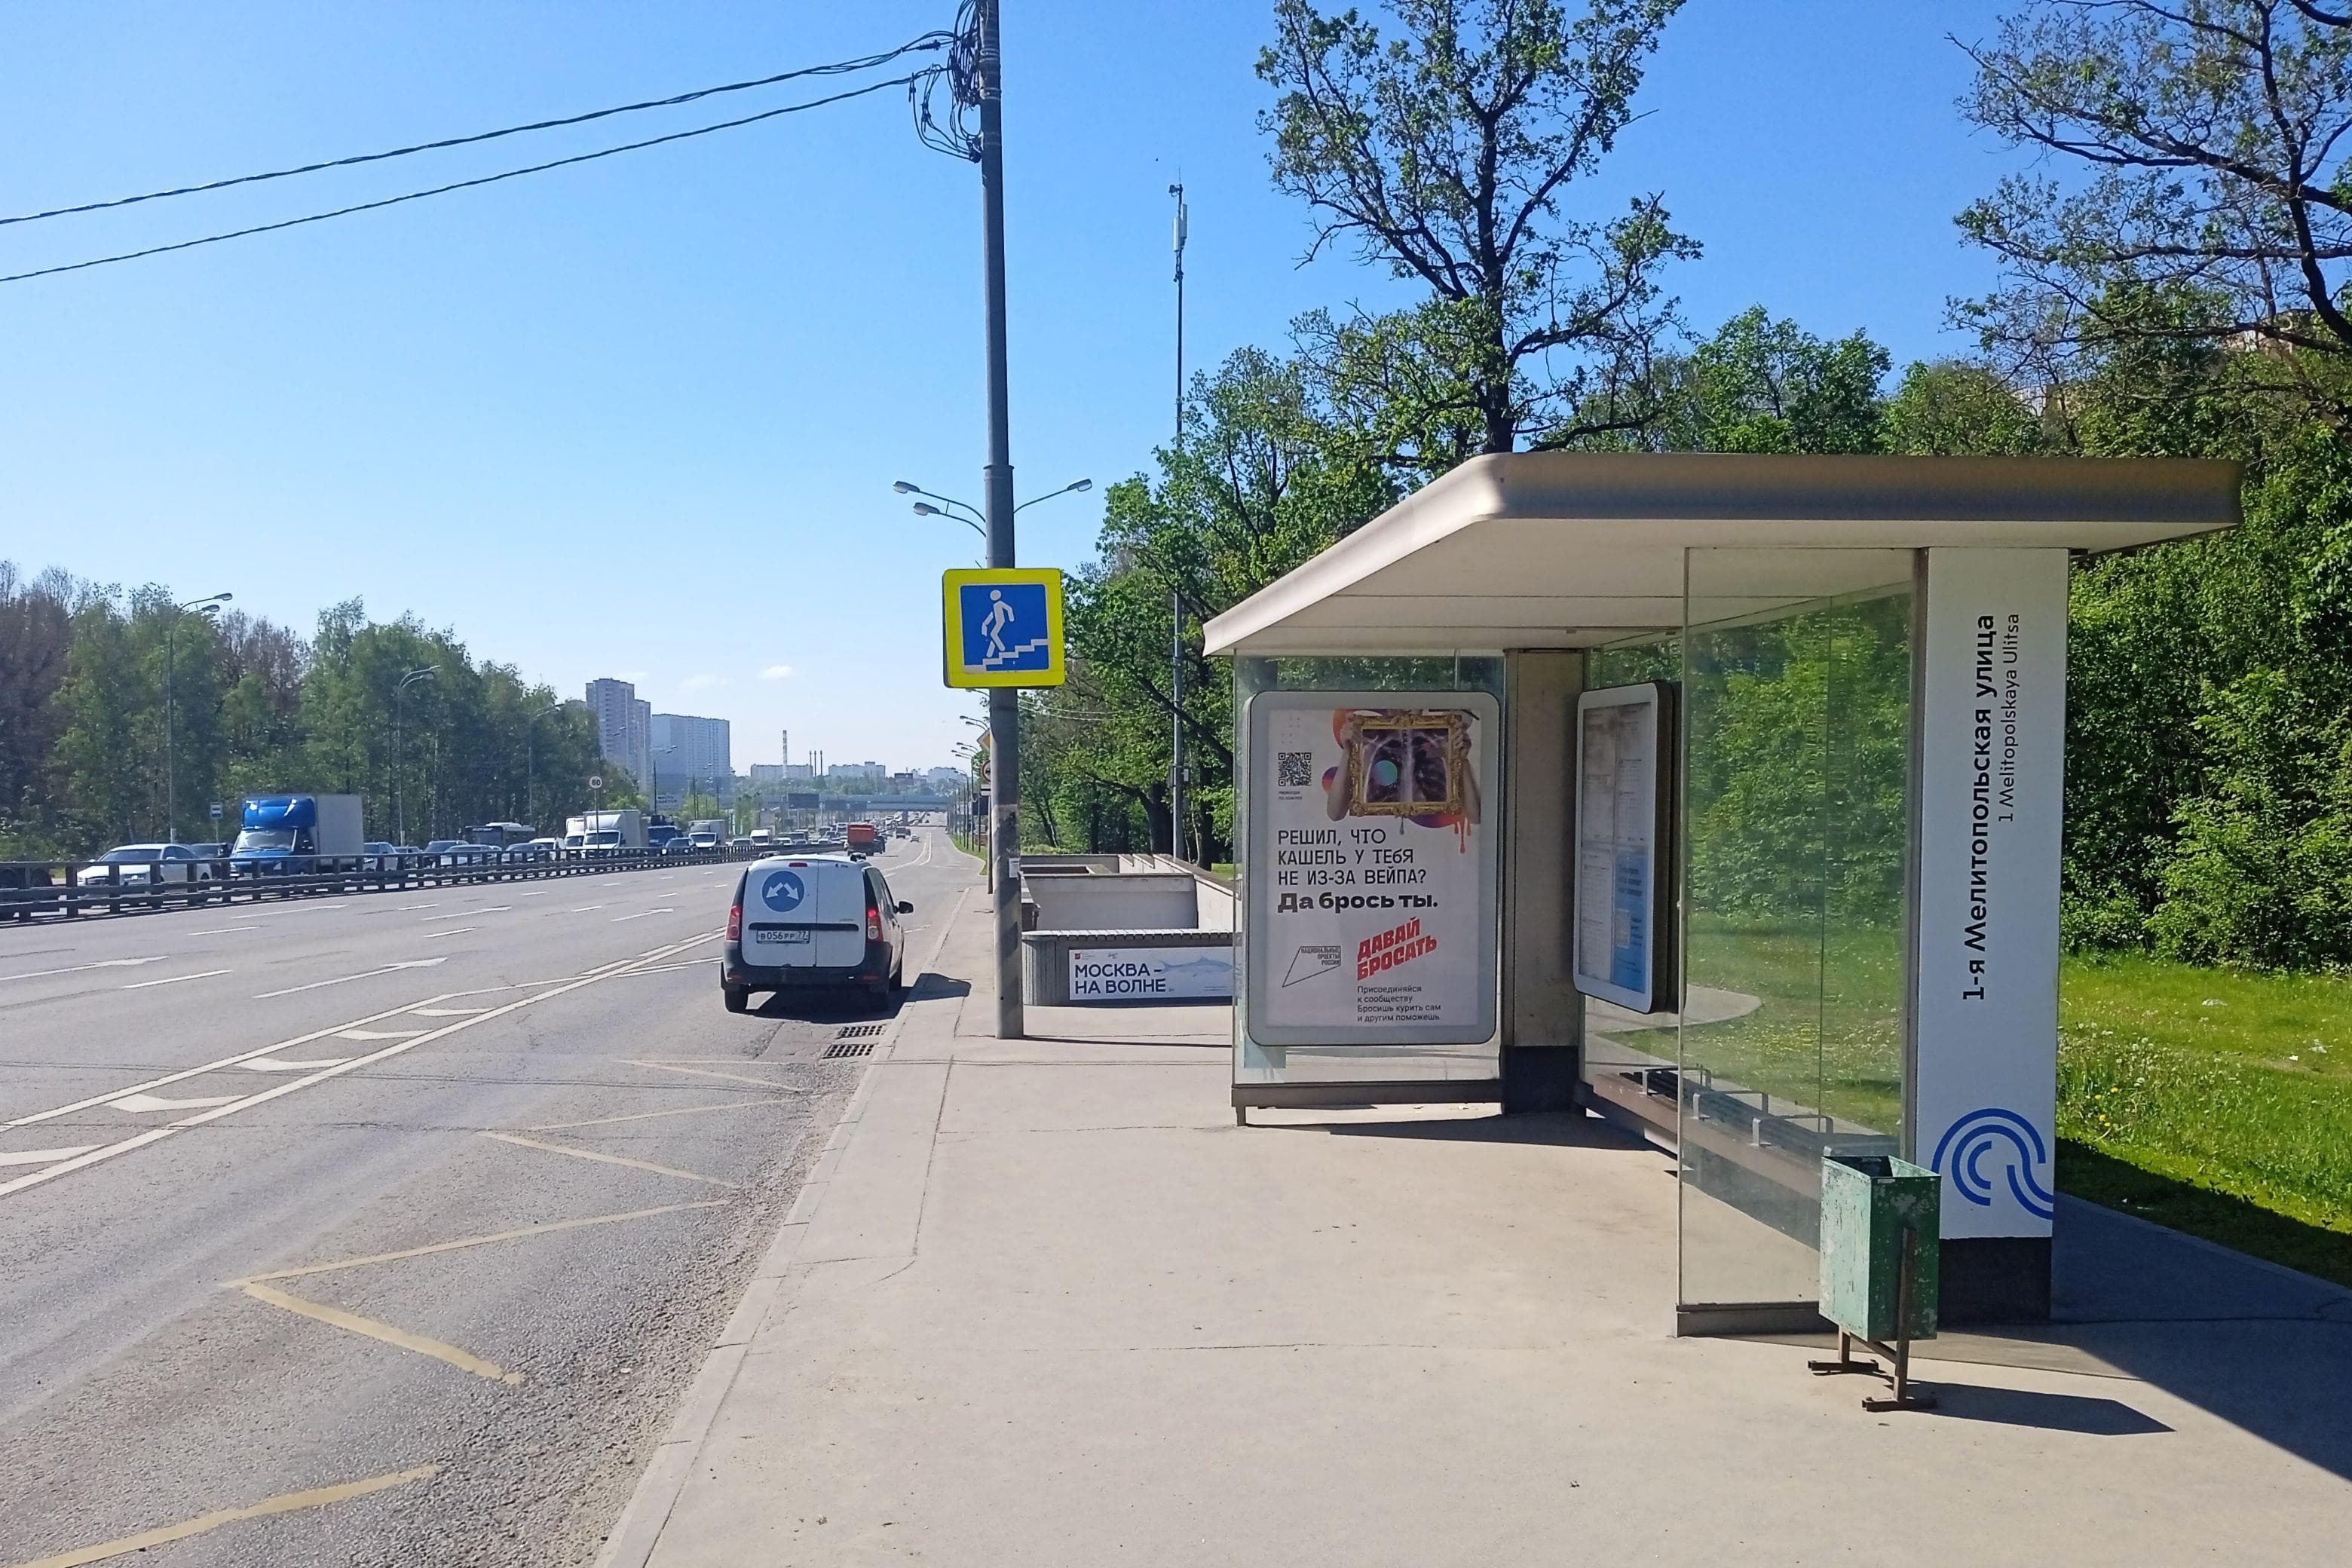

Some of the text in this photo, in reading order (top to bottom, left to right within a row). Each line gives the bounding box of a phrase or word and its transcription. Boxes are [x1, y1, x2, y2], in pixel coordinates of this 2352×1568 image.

[1998, 614, 2020, 822] 1 Melitopolskaya Ulitsa
[1962, 615, 1998, 1000] 1-я Мелитопольская улица
[1278, 828, 1386, 846] РЕШИЛ, ЧТО
[1278, 850, 1346, 865] КАШЕЛЬ
[1355, 849, 1365, 865] У
[1278, 866, 1427, 886] НЕ ИЗ-ЗА ВЕЙПА?
[1277, 892, 1438, 914] Да брось ты.
[1357, 916, 1420, 963] ДАВАЙ
[1357, 935, 1438, 981] БРОСАТЬ
[1075, 963, 1150, 978] МОСКВА
[1075, 978, 1166, 994] НА ВОЛНЕ
[1357, 985, 1422, 994] Присоединяйся
[1357, 1004, 1394, 1013] Бросишь
[1364, 1015, 1394, 1023] другим
